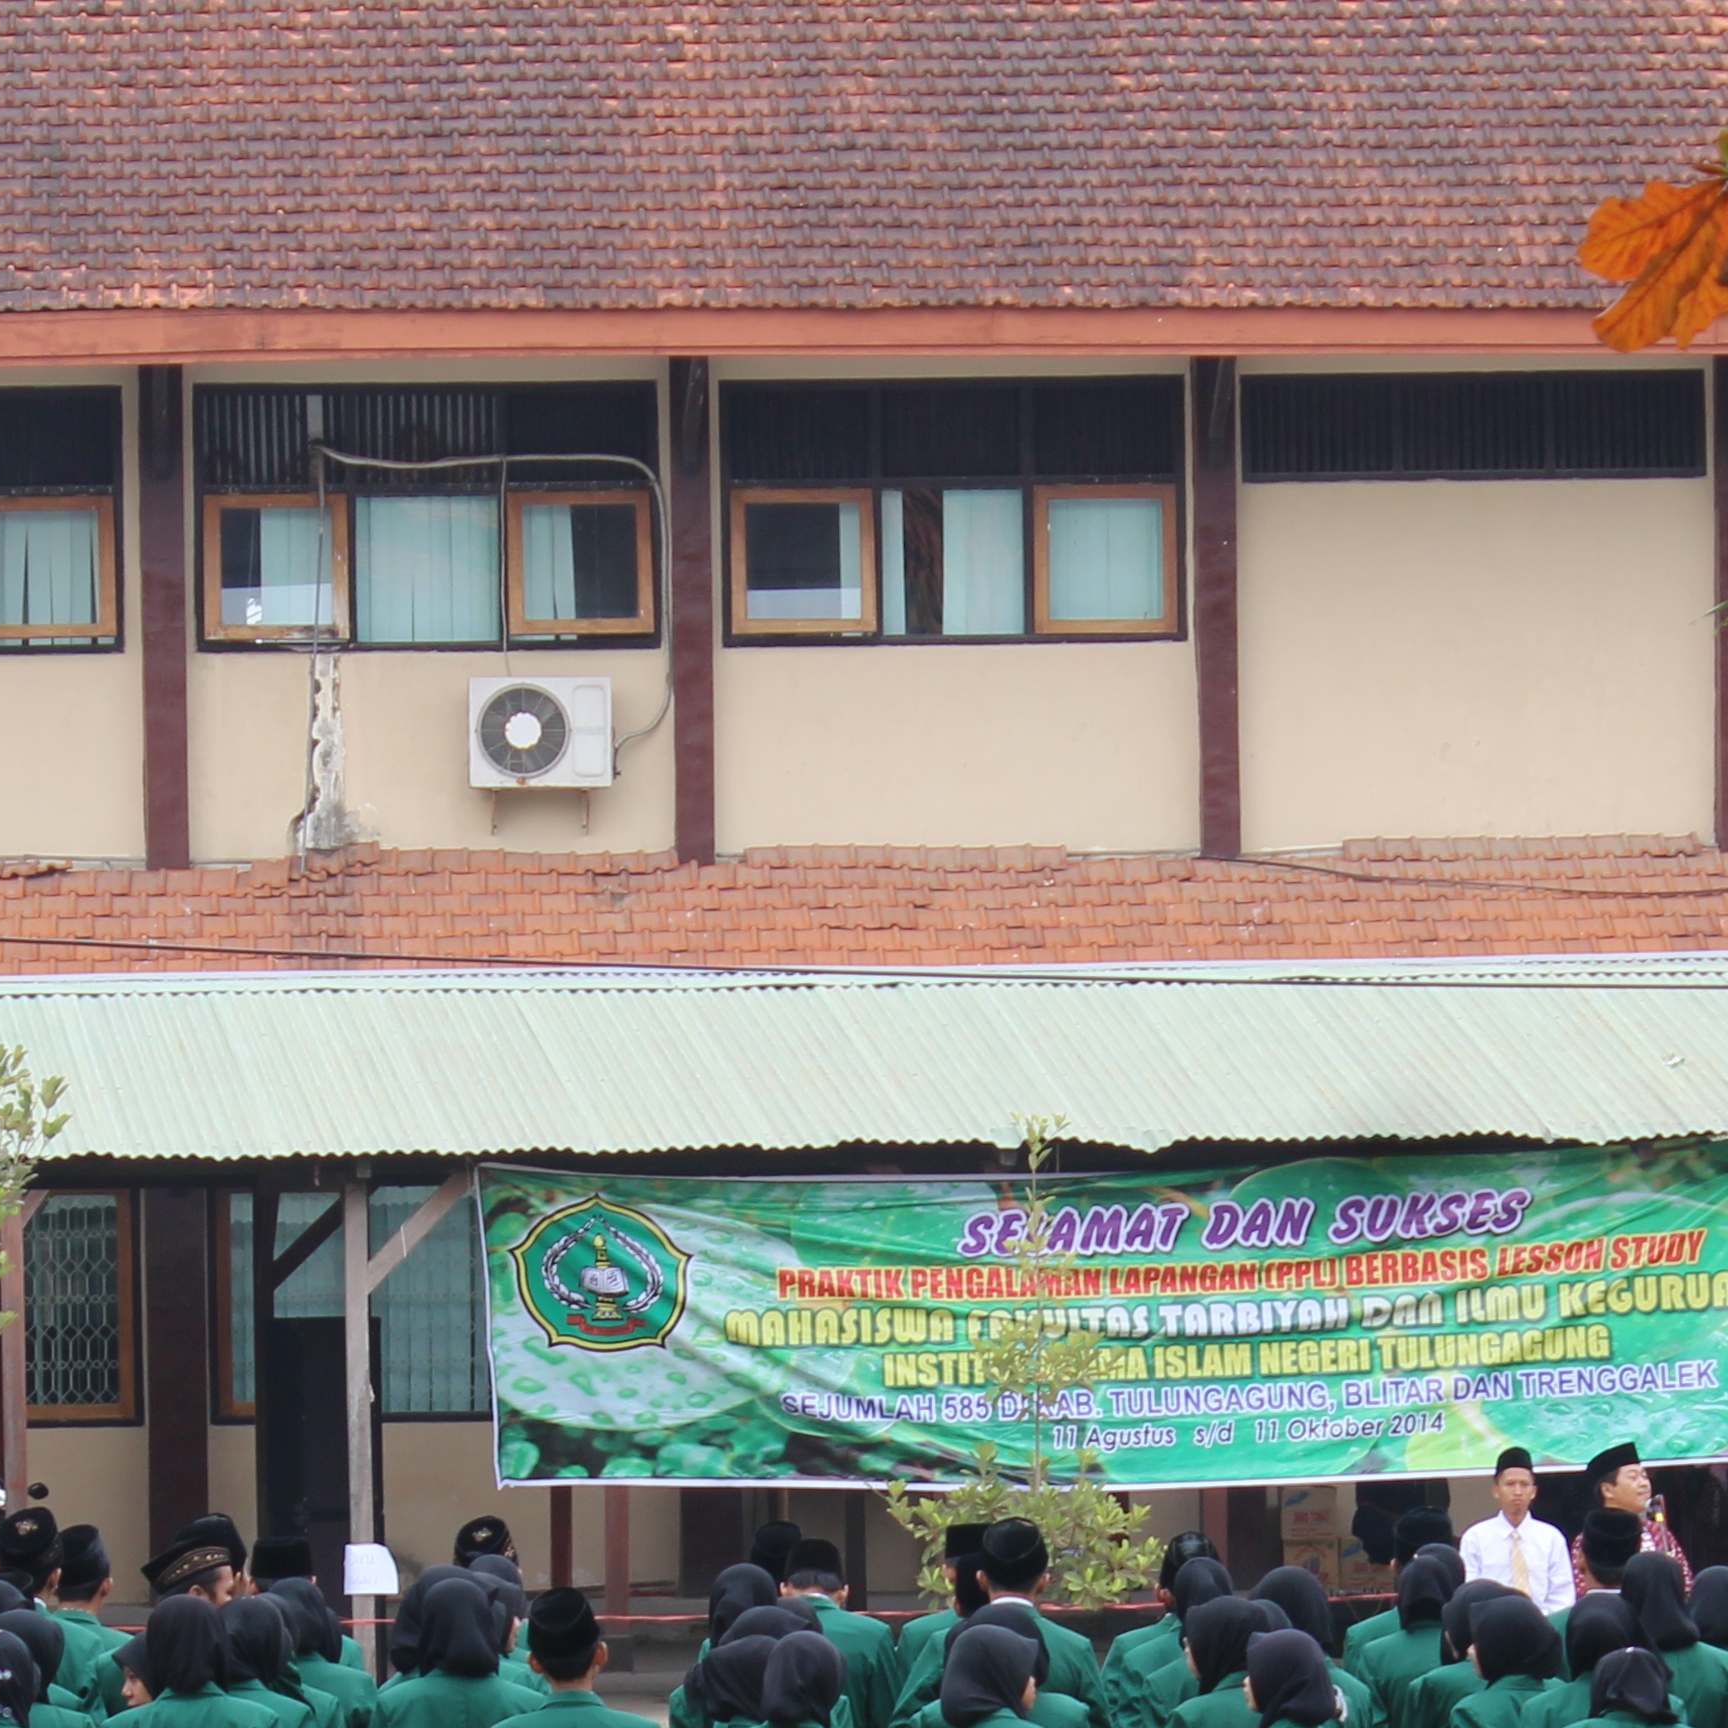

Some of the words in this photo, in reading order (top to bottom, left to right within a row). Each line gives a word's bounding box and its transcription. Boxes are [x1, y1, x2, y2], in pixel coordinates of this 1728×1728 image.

[1202, 1199, 1314, 1247] DAN
[1329, 1189, 1531, 1242] SUKSES
[778, 1268, 905, 1298] PRAKTIK
[911, 1267, 1101, 1298] PENGALAMAN
[1111, 1262, 1257, 1296] LAPANGAN
[1264, 1259, 1337, 1289] (PPL)
[1346, 1249, 1488, 1285] BERBASIS
[1496, 1238, 1606, 1277] LESSON
[1609, 1229, 1707, 1270] STUDY
[726, 1309, 955, 1345] MAHASISWA
[1159, 1300, 1349, 1336] TARBIYAH
[1362, 1294, 1444, 1326] DAN
[1455, 1285, 1546, 1323] ILMU
[884, 1354, 1025, 1385] INSTIT
[1154, 1345, 1252, 1377] ISLAM
[1260, 1341, 1370, 1374] NEGERI
[1377, 1325, 1610, 1369] TULUNGAGUNG
[782, 1394, 935, 1420] SEJUMLAH
[943, 1396, 991, 1419] 585
[1109, 1384, 1335, 1414] TULUNGAGUNG,
[1344, 1379, 1444, 1408] BLITAR
[1454, 1373, 1511, 1400] DAN
[1521, 1361, 1718, 1397] TRENGGALEK
[1053, 1426, 1076, 1448] 11
[1087, 1424, 1173, 1451] Agustus
[1194, 1424, 1233, 1446] s/d
[1256, 1422, 1278, 1442] 11
[1287, 1418, 1382, 1440] Oktober
[1391, 1413, 1444, 1434] 2014
